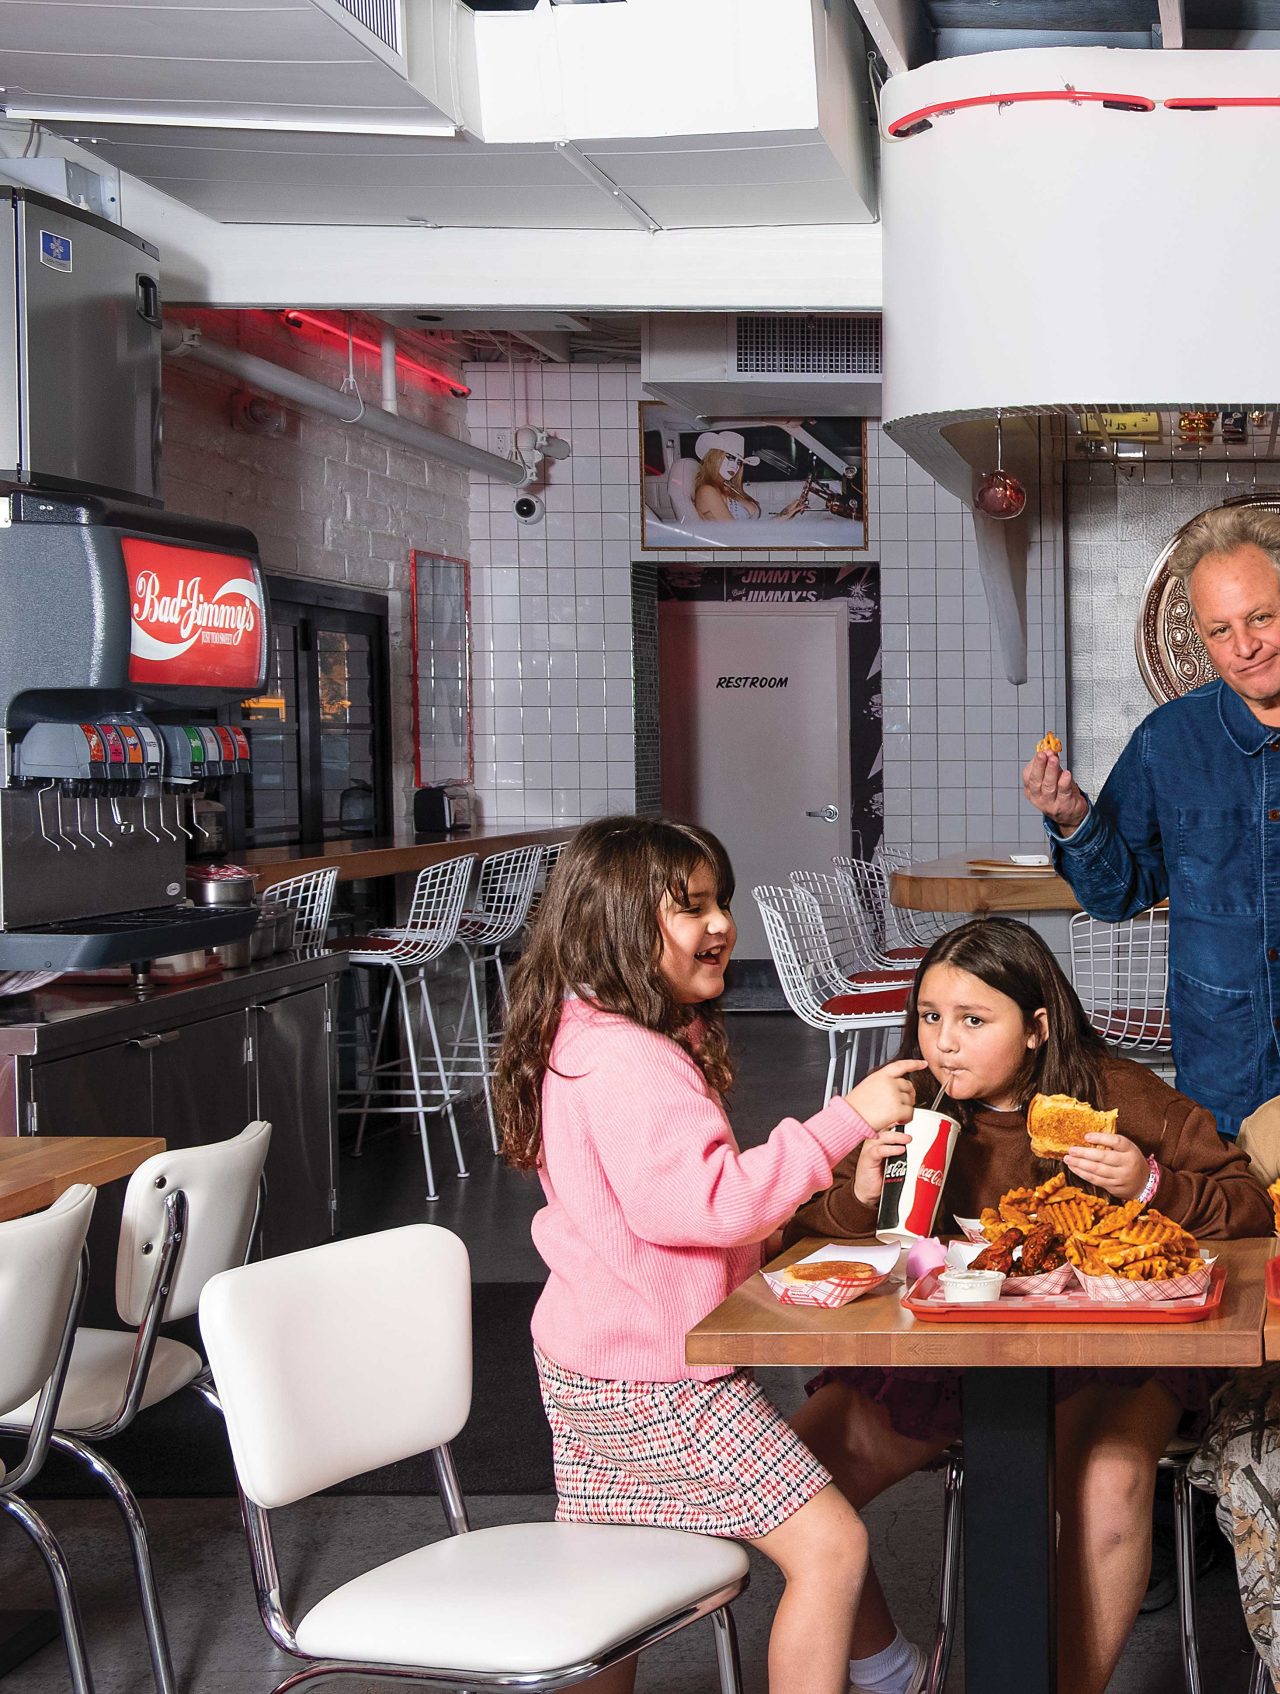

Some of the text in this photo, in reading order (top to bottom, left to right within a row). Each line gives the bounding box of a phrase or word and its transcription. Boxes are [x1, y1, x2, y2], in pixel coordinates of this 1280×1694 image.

[741, 570, 817, 584] JIMMY'S
[741, 590, 817, 602] JIMMY'S
[716, 676, 789, 689] RESTROOM
